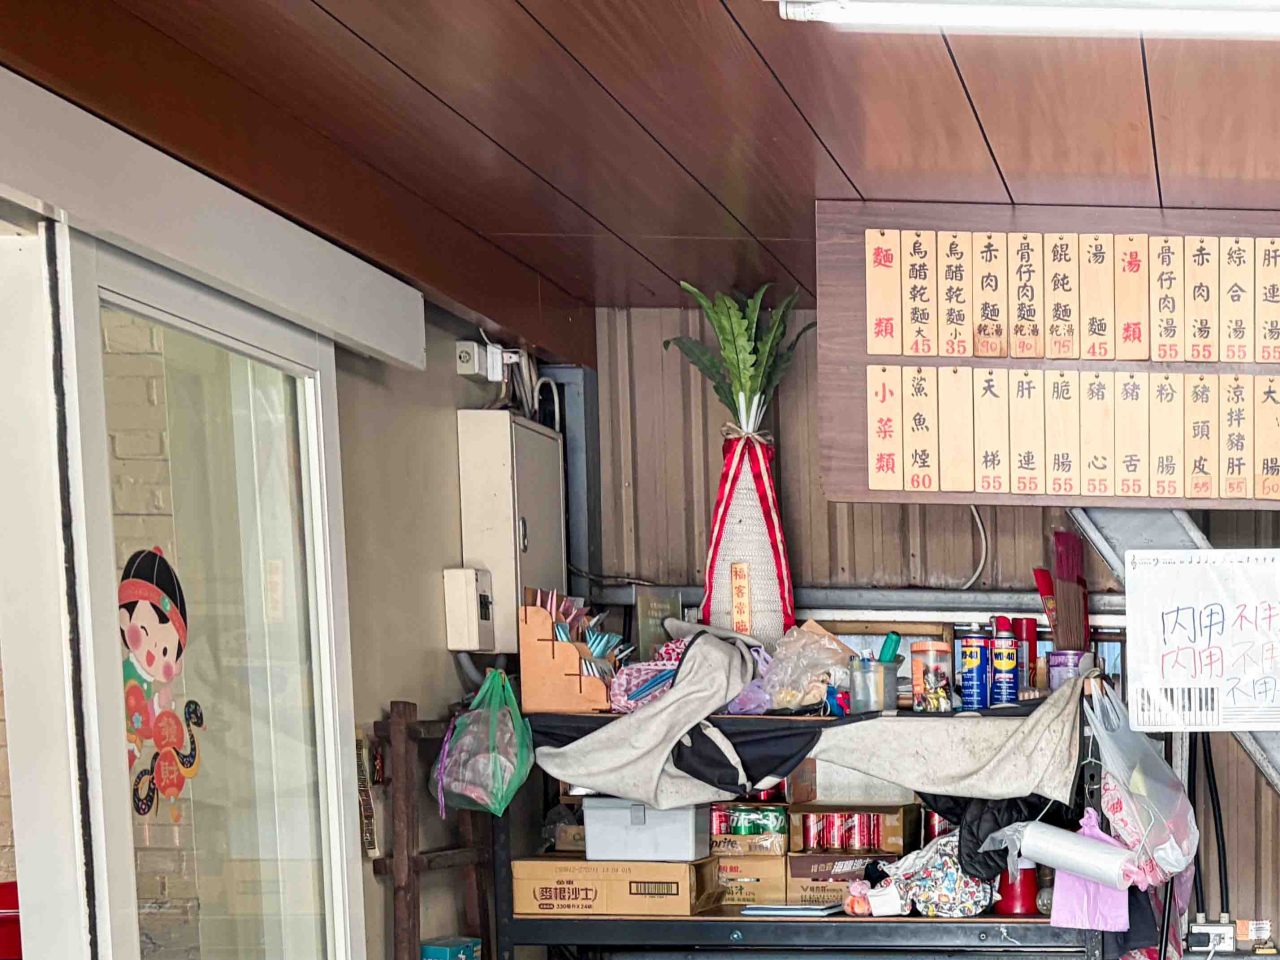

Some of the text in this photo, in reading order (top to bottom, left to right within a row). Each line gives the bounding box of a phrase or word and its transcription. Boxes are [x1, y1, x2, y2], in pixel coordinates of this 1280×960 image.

[873, 246, 894, 338] 麵類
[980, 242, 1000, 321] 赤肉麵
[1016, 243, 1036, 321] 骨仔肉麵
[1051, 243, 1072, 321] 餛飩麵
[1086, 244, 1108, 357] 湯麵 45
[1121, 251, 1142, 343] 湯類
[1157, 245, 1179, 359] 骨仔肉湯 55
[1191, 246, 1212, 359] 赤肉湯 55
[1226, 246, 1247, 359] 綜合湯 55
[911, 339, 931, 353] 45
[946, 340, 967, 354] 35
[981, 340, 998, 352] 90
[1018, 340, 1033, 353] 90
[1054, 340, 1072, 354] 75
[874, 382, 896, 474] 小菜類
[911, 376, 932, 489] 鯊魚煙 60
[981, 378, 1002, 490] 天梯 55
[1016, 380, 1038, 491] 肝連 55
[1052, 380, 1073, 492] 脆腸 55
[1087, 381, 1107, 493] 豬心 55
[1121, 381, 1142, 494] 豬舌 55
[1156, 383, 1177, 495] 粉腸 55
[1191, 384, 1211, 493] 豬頭皮 55
[1226, 384, 1246, 493] 涼拌豬肝 55
[1261, 385, 1280, 476] 大腸
[994, 652, 1015, 661] WD-40
